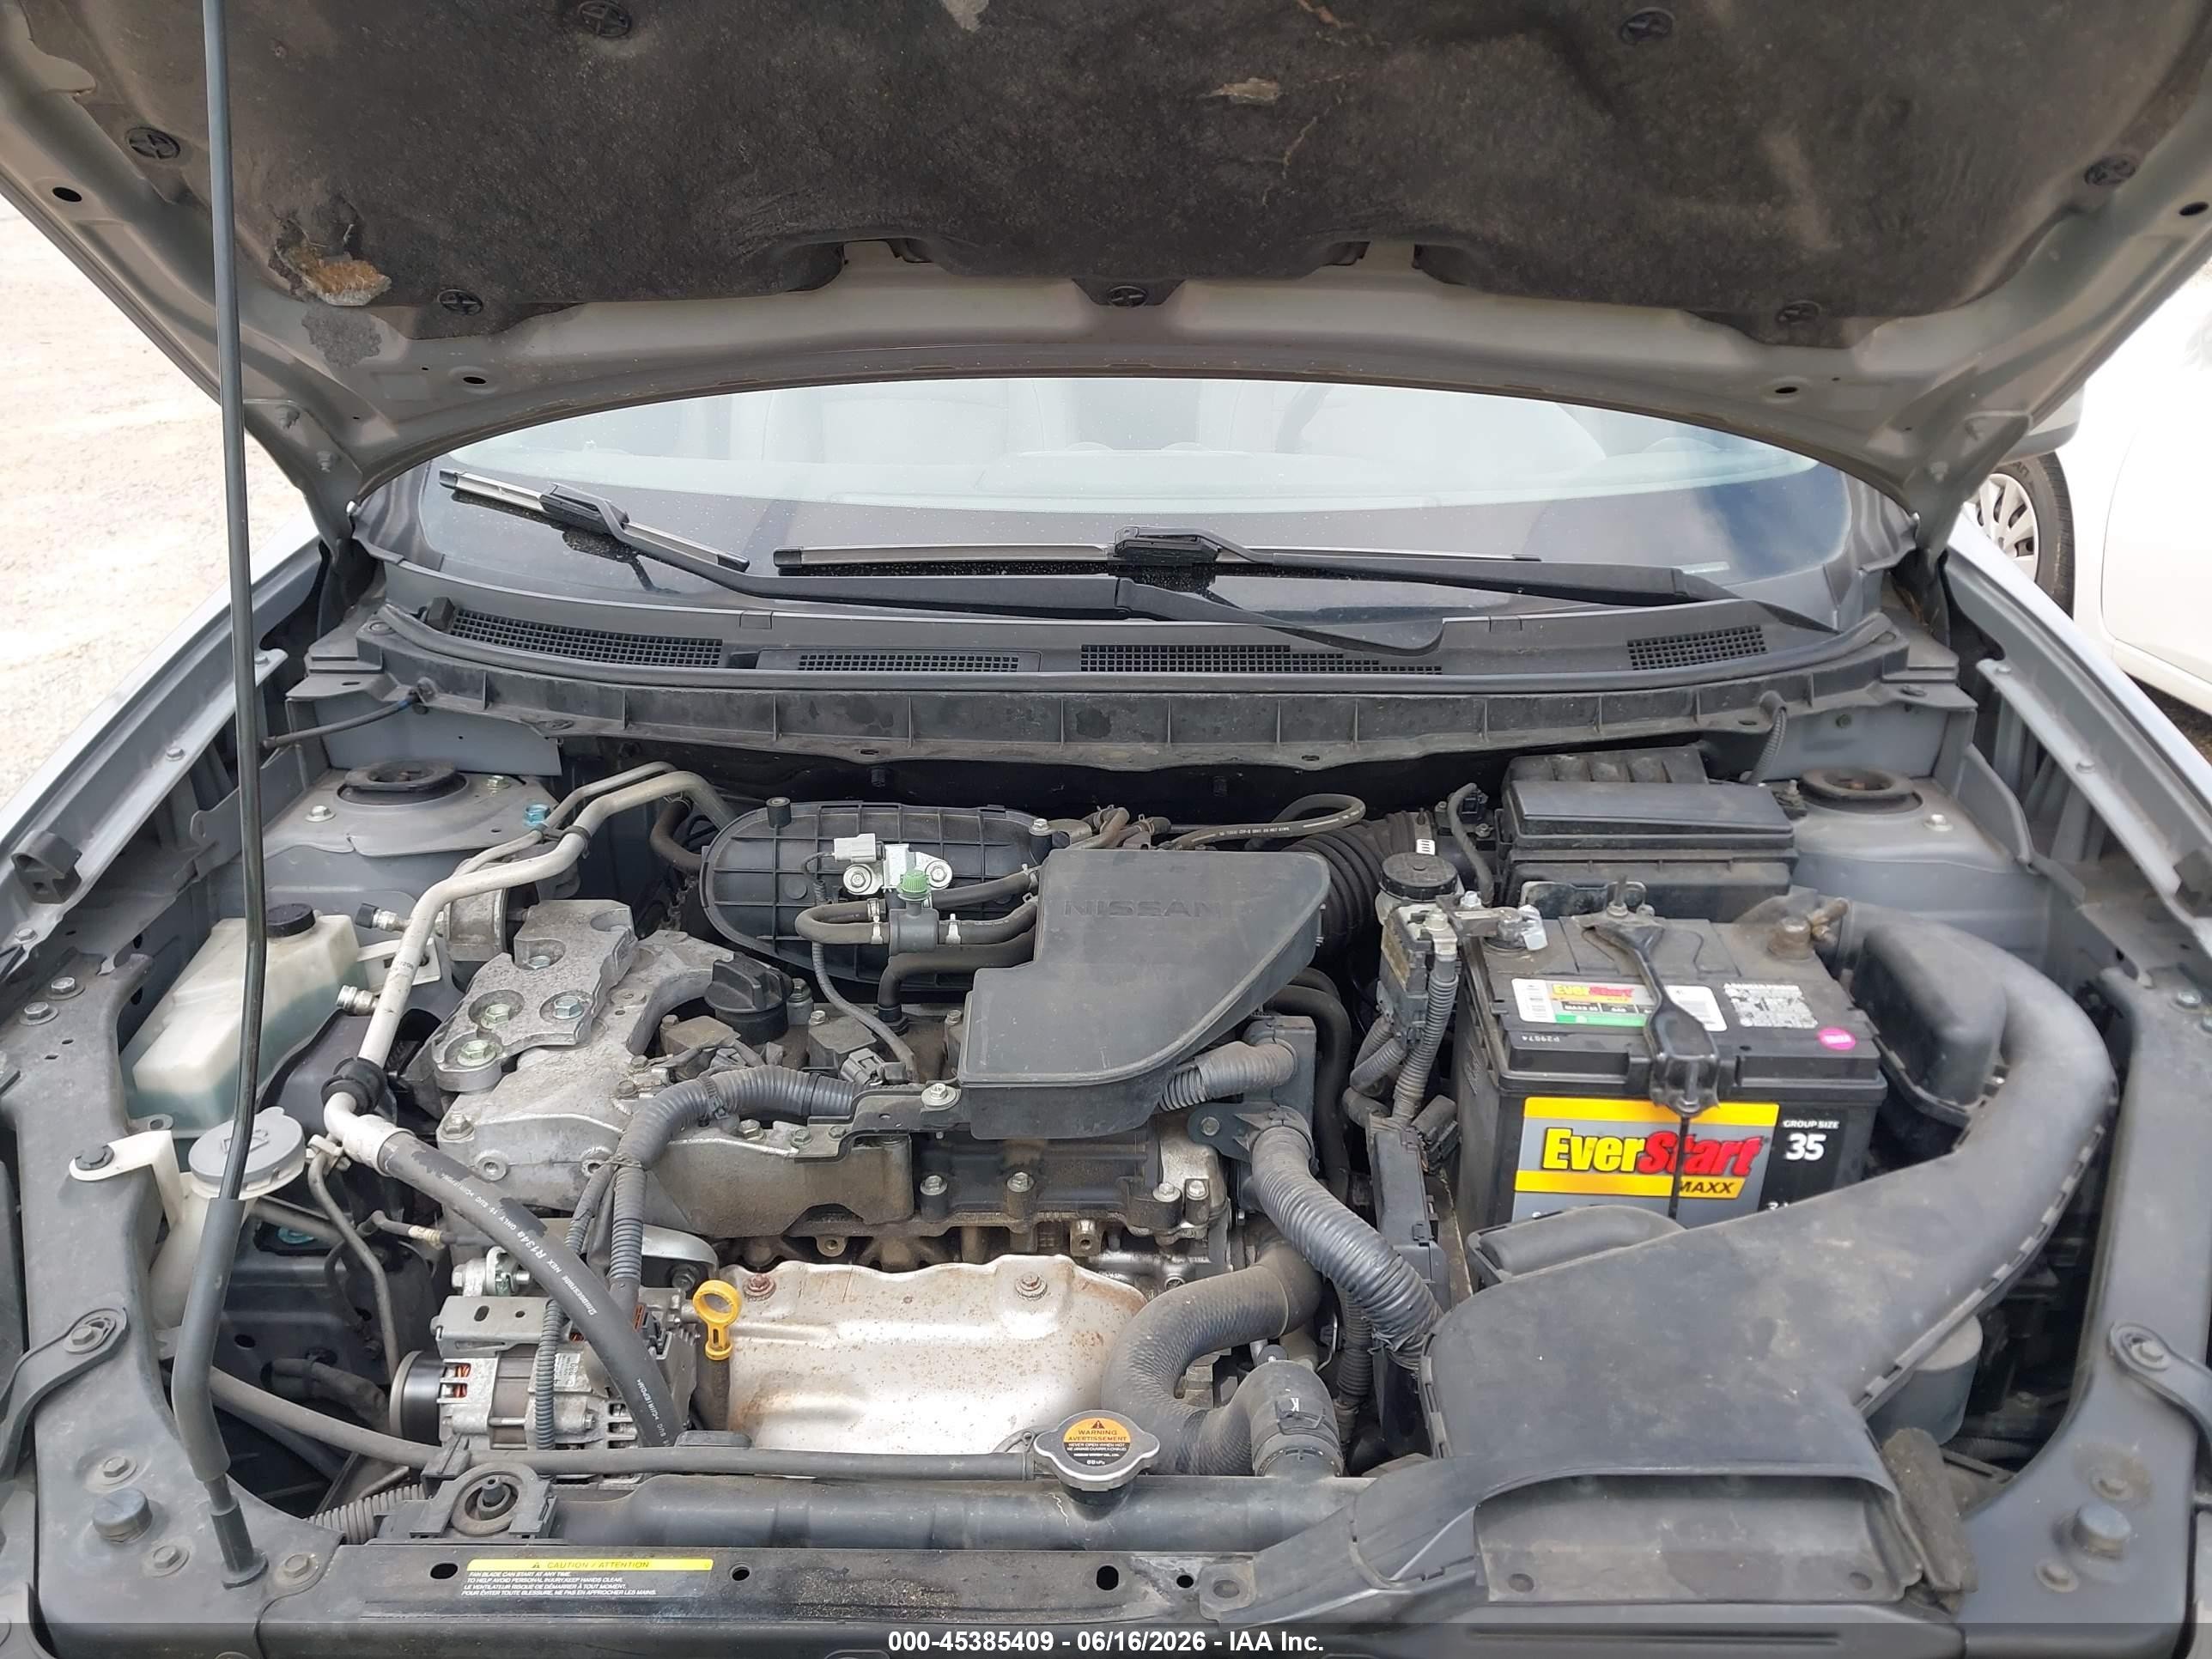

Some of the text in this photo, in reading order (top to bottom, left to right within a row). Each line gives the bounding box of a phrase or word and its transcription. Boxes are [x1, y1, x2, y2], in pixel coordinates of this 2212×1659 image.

[1064, 899, 1221, 918] NISSAN
[1783, 1119, 1840, 1129] GROUP SIZE
[1542, 1127, 1765, 1177] EverStart
[1785, 1132, 1827, 1162] 35
[1679, 1180, 1735, 1194] MAXX
[516, 1231, 548, 1260] R134a
